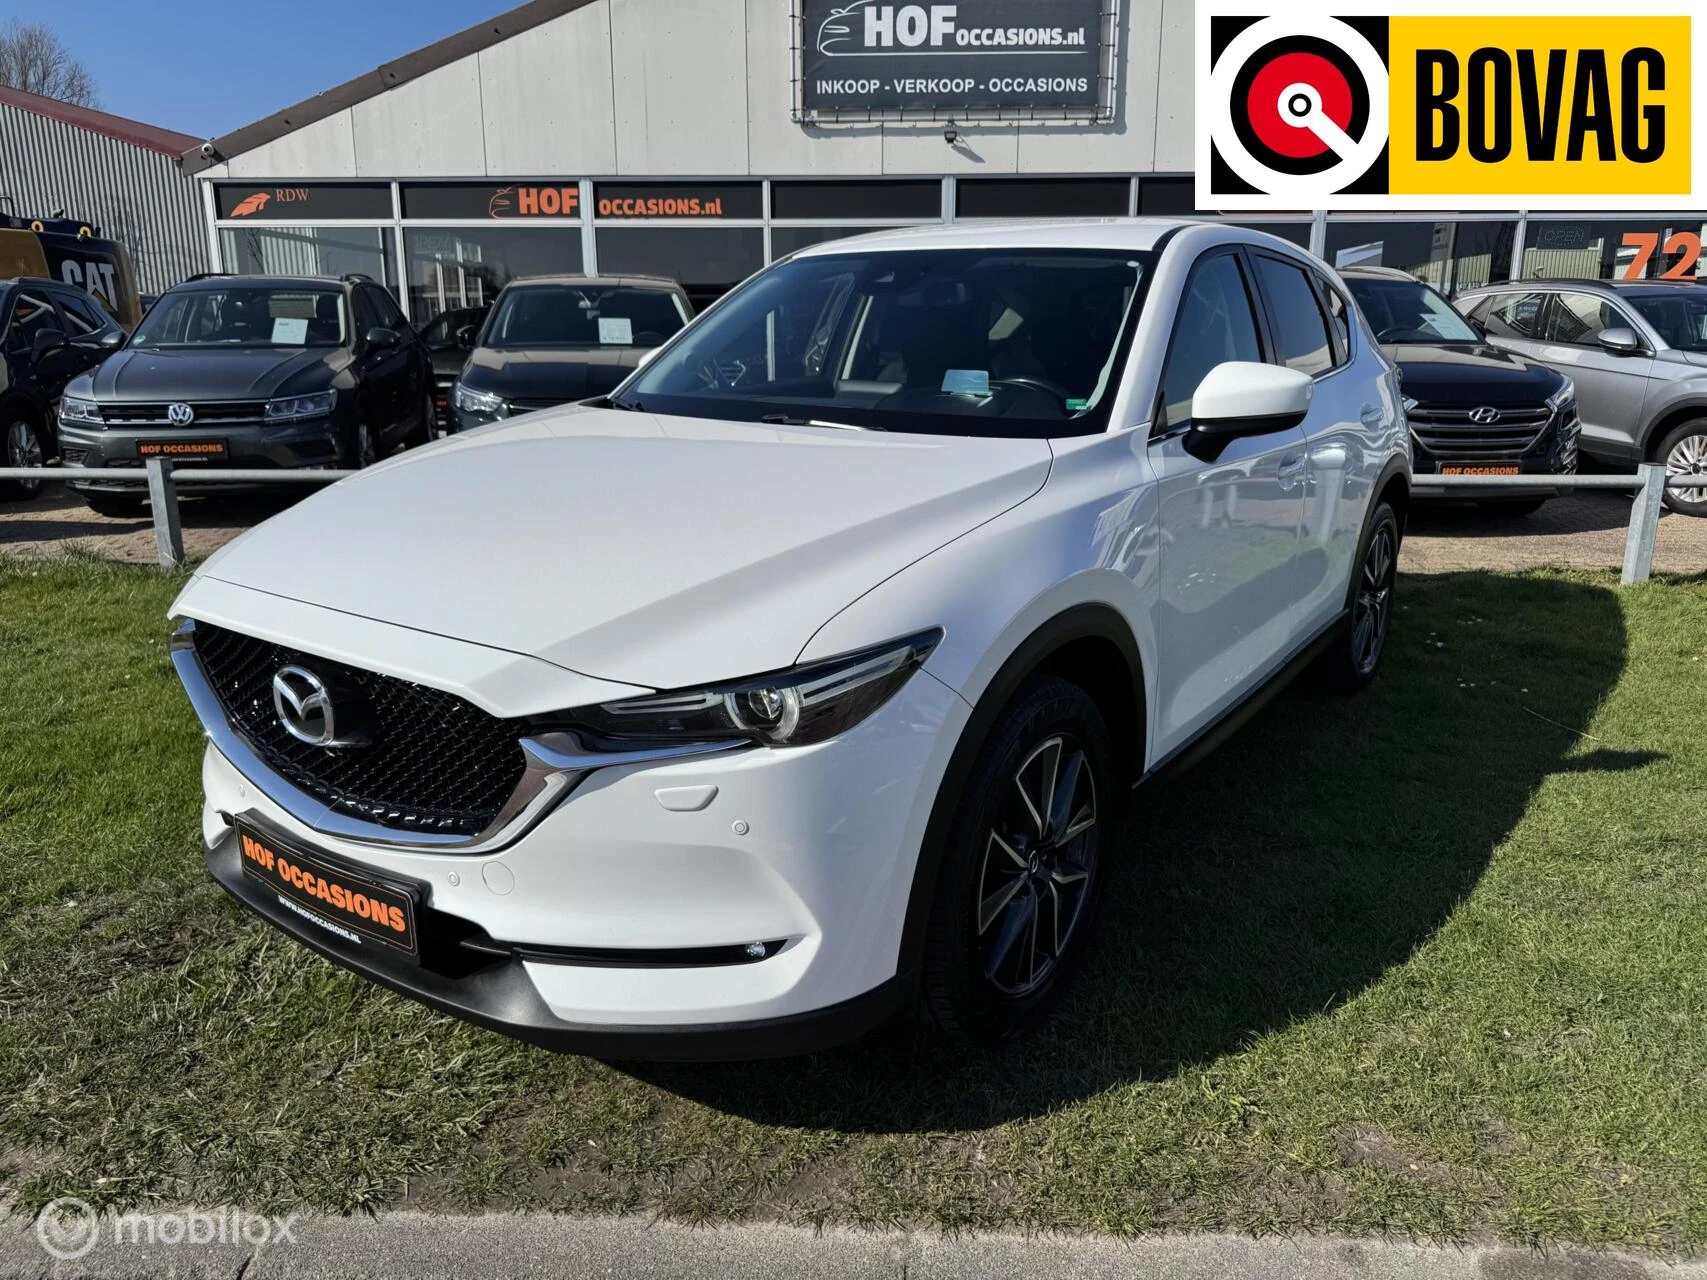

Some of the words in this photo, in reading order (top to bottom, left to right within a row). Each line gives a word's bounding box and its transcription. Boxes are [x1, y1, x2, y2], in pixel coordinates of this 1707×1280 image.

[864, 5, 957, 47] HOF
[956, 27, 1085, 46] OCCASIONS.nl
[816, 80, 880, 94] INKOOP
[893, 79, 975, 94] VERKOOP
[989, 78, 1088, 92] OCCASIONS
[276, 188, 309, 202] RDW
[518, 187, 580, 215] HOF
[599, 198, 722, 216] OCCASIONS.nl
[1544, 229, 1585, 242] OPEN
[1622, 231, 1702, 285] 72
[61, 259, 118, 312] CAT
[140, 445, 161, 454] HOF
[163, 444, 224, 453] OCCASIONS
[1442, 467, 1462, 475] HOF
[1463, 466, 1519, 475] OCCASIONS
[242, 834, 275, 871] HOF
[278, 859, 407, 933] OCCASIONS
